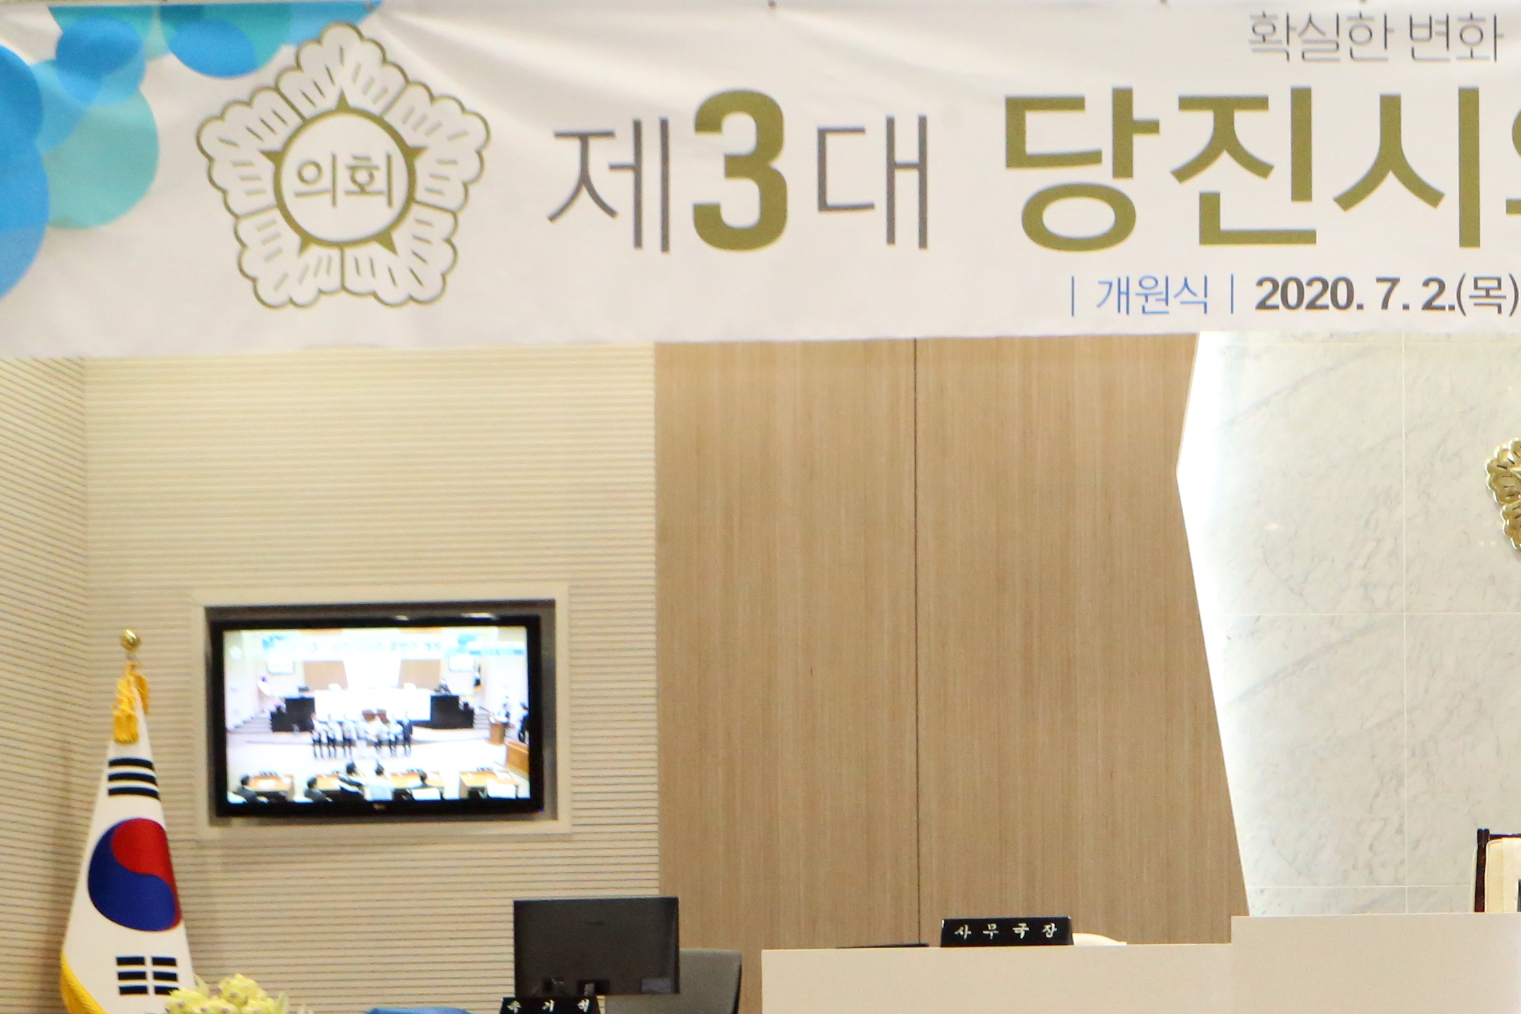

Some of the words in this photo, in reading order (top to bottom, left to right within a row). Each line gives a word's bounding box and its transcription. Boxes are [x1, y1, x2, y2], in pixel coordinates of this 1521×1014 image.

[1249, 11, 1396, 62] 확실한
[1409, 12, 1504, 62] 변화
[293, 150, 395, 208] 의회
[547, 88, 928, 254] 제3대
[1096, 274, 1209, 316] 개원식
